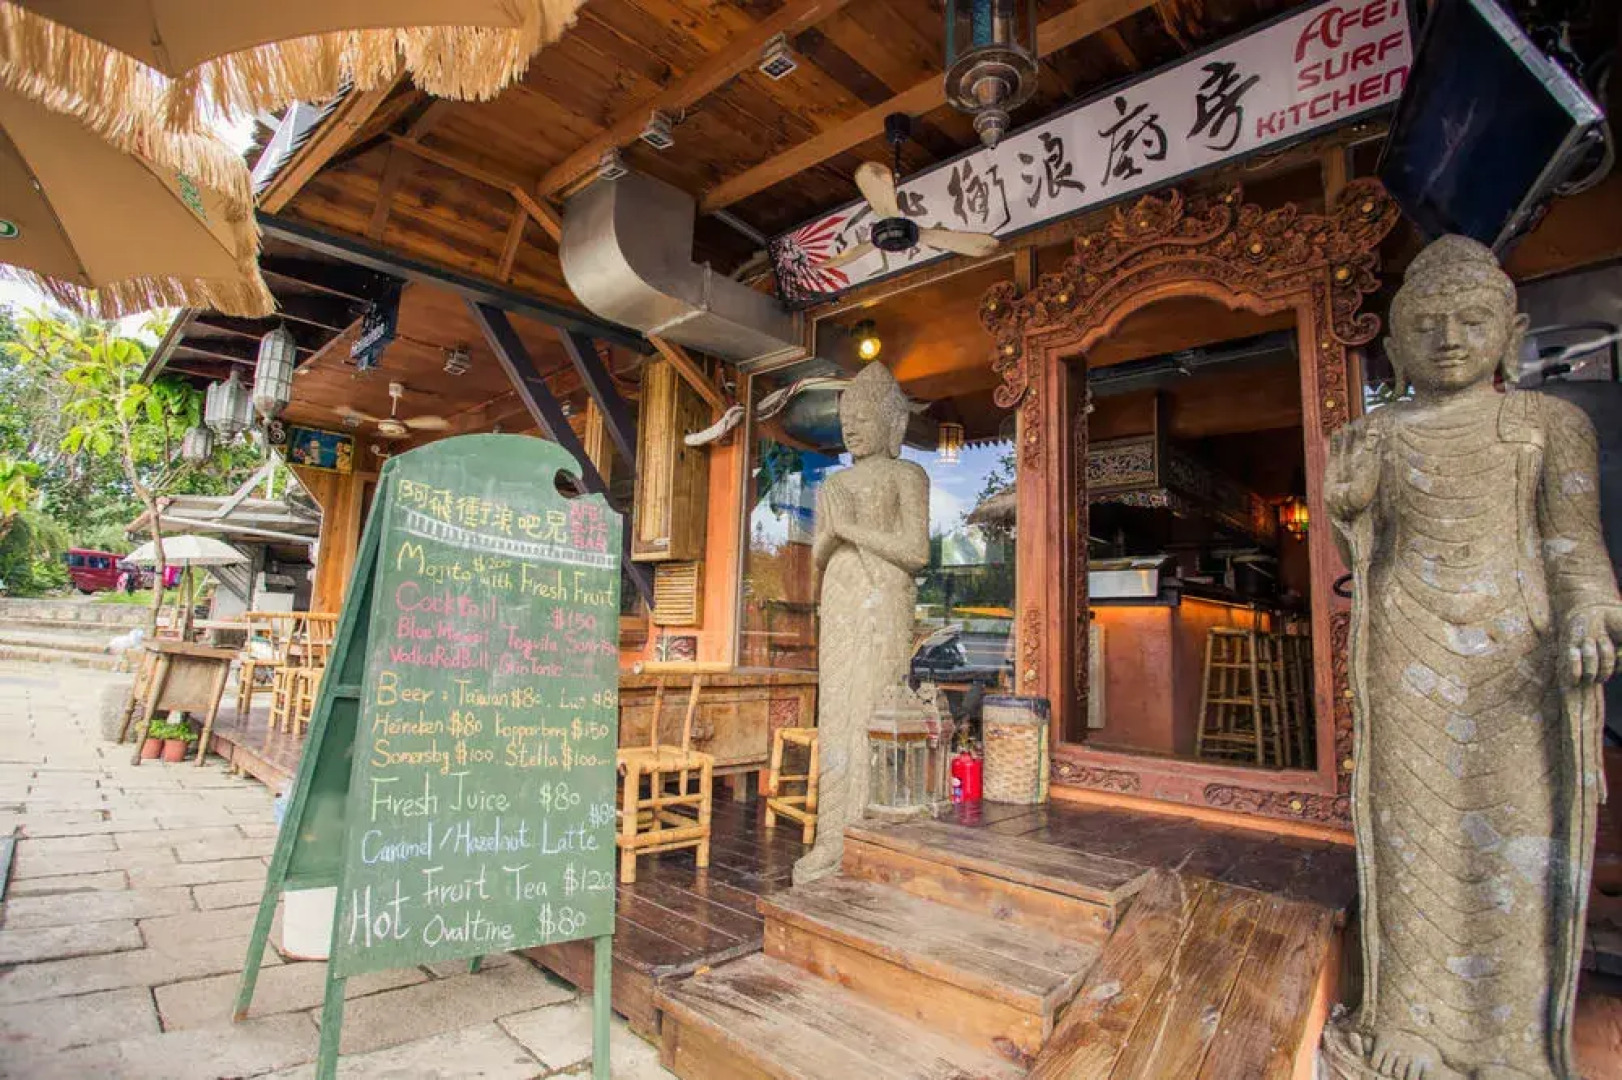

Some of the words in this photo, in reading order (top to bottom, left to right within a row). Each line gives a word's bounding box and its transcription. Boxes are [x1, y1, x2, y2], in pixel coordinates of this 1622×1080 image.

[1297, 30, 1404, 91] SURF
[397, 541, 471, 584] Mojito
[520, 562, 567, 600] Fresh
[573, 570, 614, 607] Fruit
[395, 581, 497, 621] Cocktail
[553, 607, 596, 632] $150
[397, 614, 432, 640] Blue
[377, 670, 435, 706] Beer
[450, 709, 483, 738] $80
[570, 717, 609, 741] $150
[370, 771, 438, 822] Fresh
[449, 771, 511, 812] Juice
[540, 780, 581, 813] $80
[541, 817, 599, 855] Latte
[422, 863, 493, 905] Fruit
[502, 863, 548, 901] Tea
[564, 861, 612, 897] $120
[348, 878, 410, 948] Hot
[422, 909, 516, 948] Ovaltine
[537, 902, 587, 941] $80
